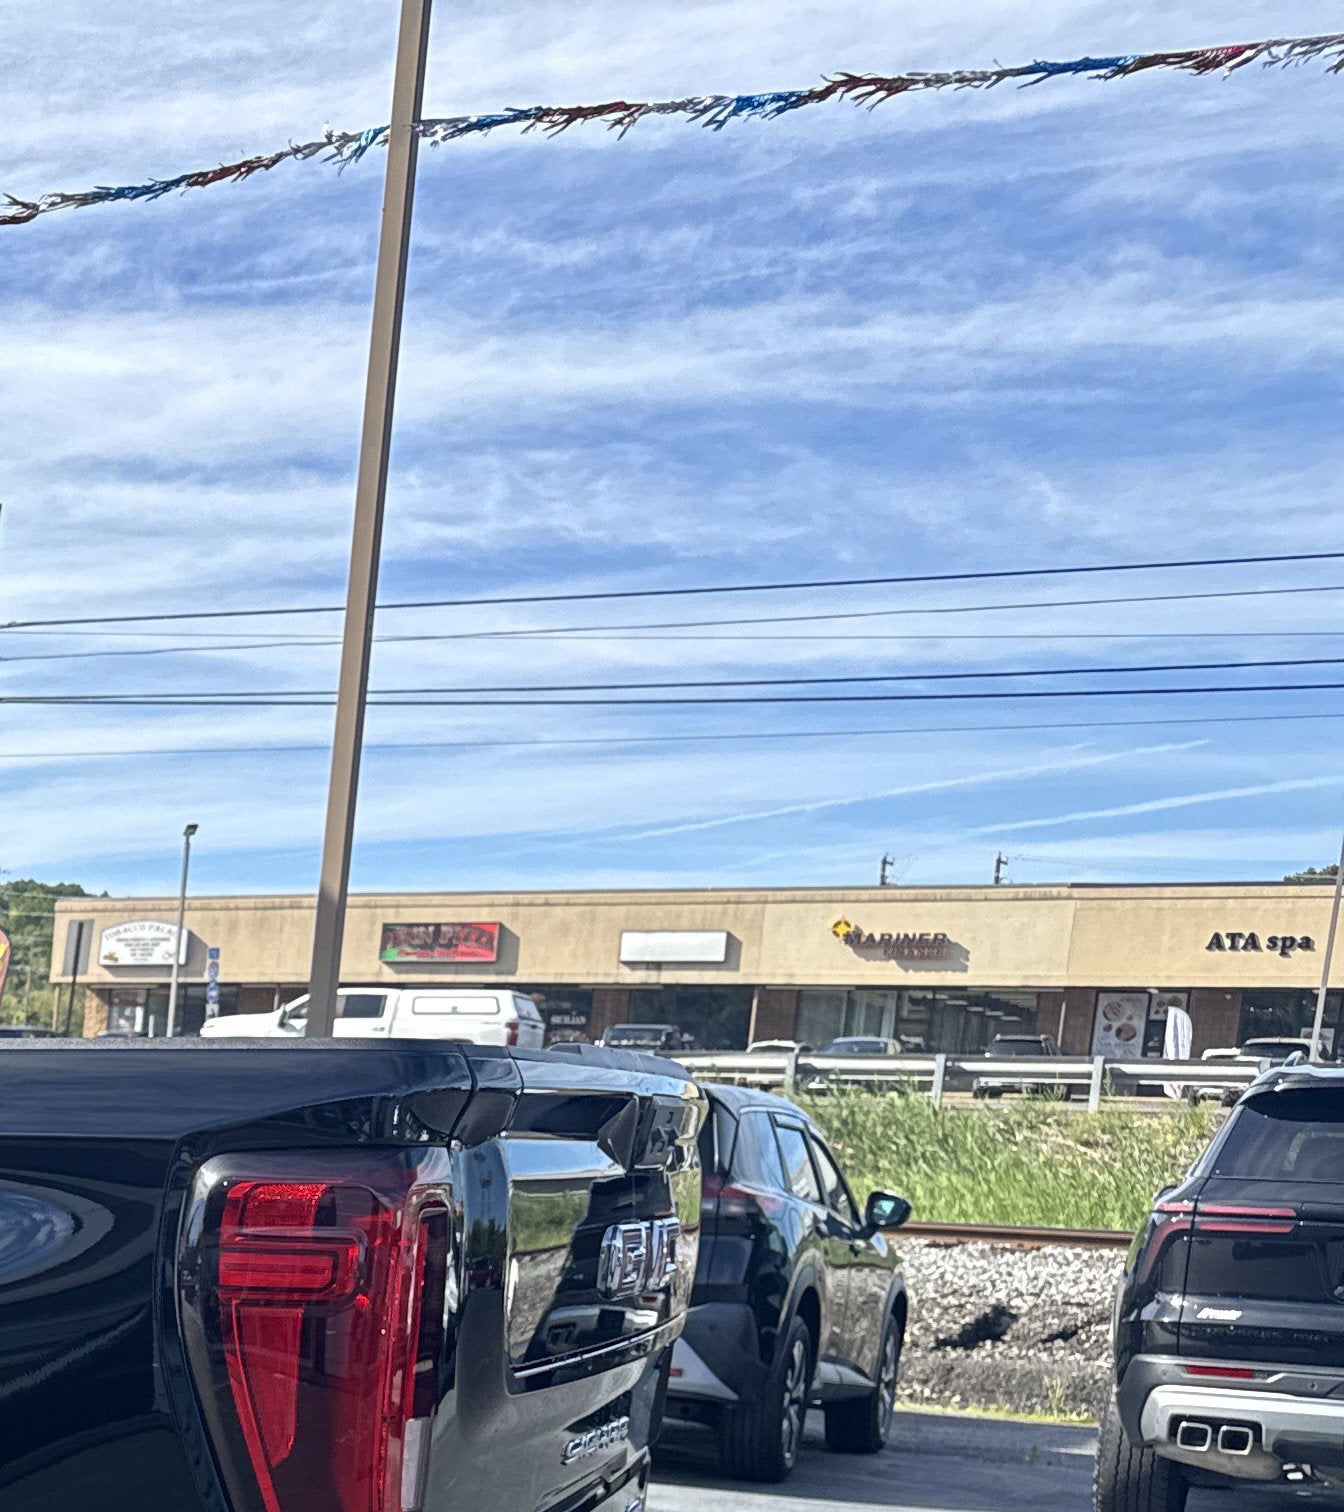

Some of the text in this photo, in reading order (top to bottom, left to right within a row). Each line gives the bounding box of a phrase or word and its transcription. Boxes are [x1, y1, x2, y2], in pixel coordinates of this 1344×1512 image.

[844, 932, 950, 946] MARINER
[1205, 931, 1316, 958] ATA spa
